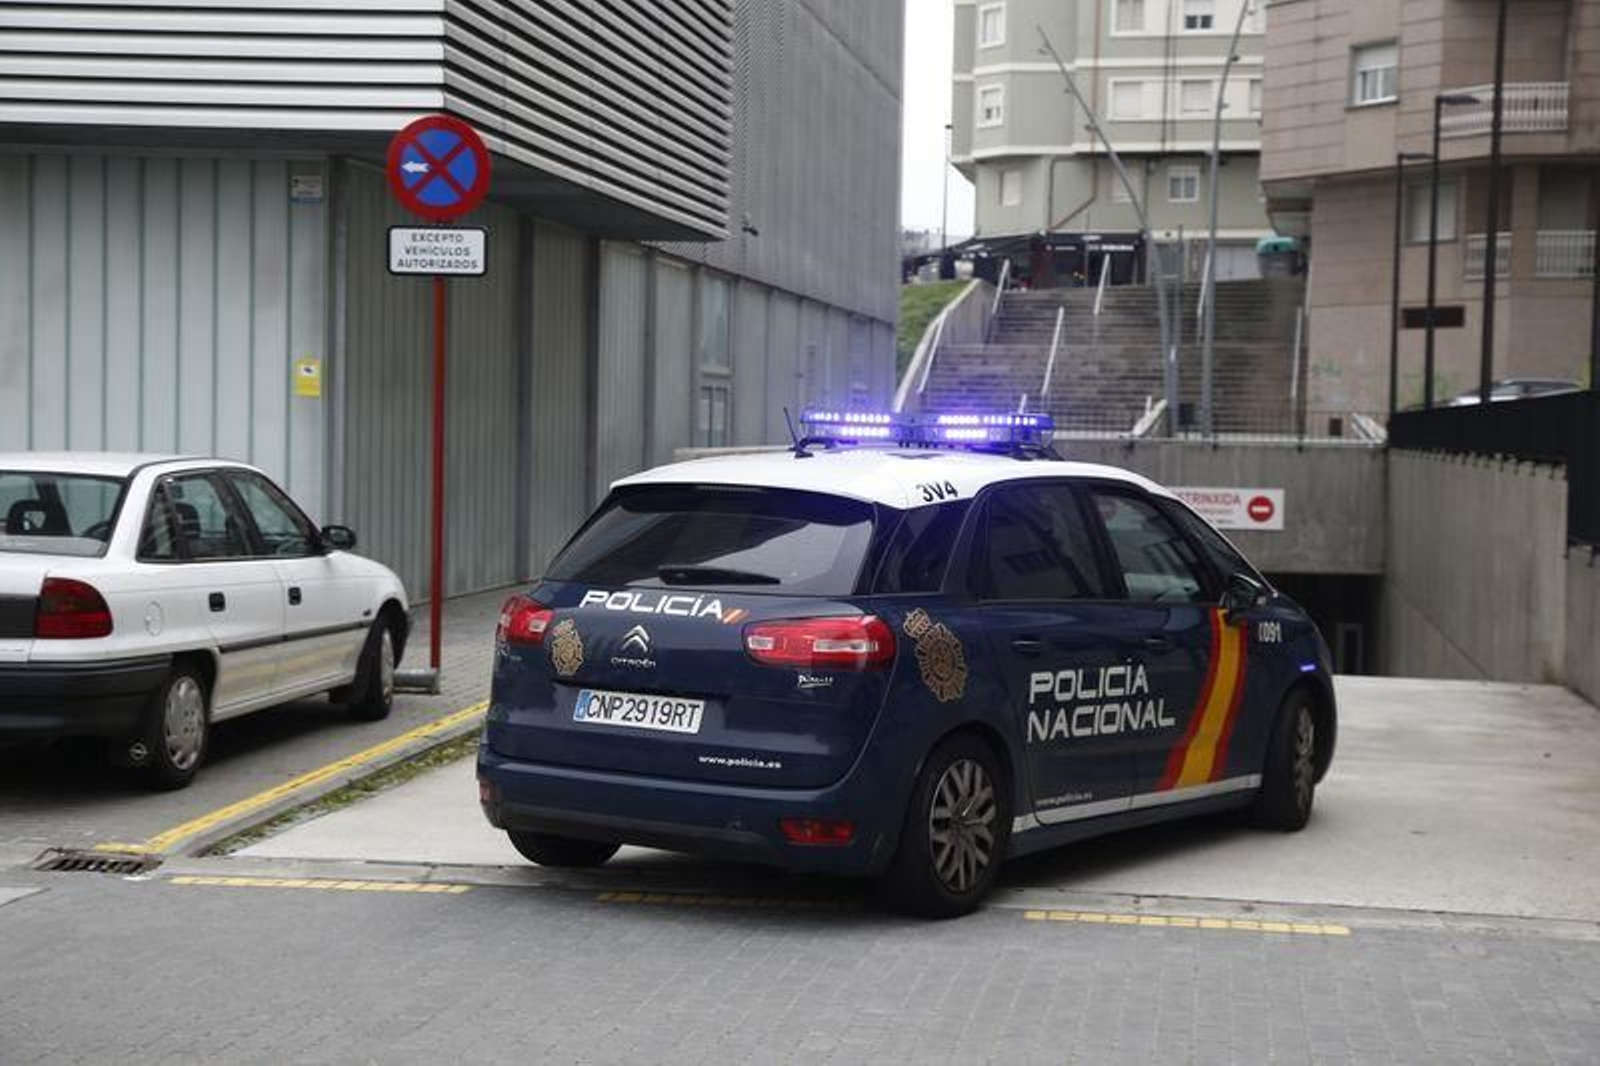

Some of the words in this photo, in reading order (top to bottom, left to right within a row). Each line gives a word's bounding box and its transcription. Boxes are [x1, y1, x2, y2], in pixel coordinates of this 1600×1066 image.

[411, 233, 464, 242] EXCEPTO
[397, 259, 478, 269] AUTORIZADOS
[915, 480, 958, 502] 3V4
[579, 589, 723, 619] POLICÍA
[1029, 657, 1149, 704] POLICÍA
[586, 694, 700, 728] CNP2919RT
[1026, 699, 1176, 743] NACIONAL
